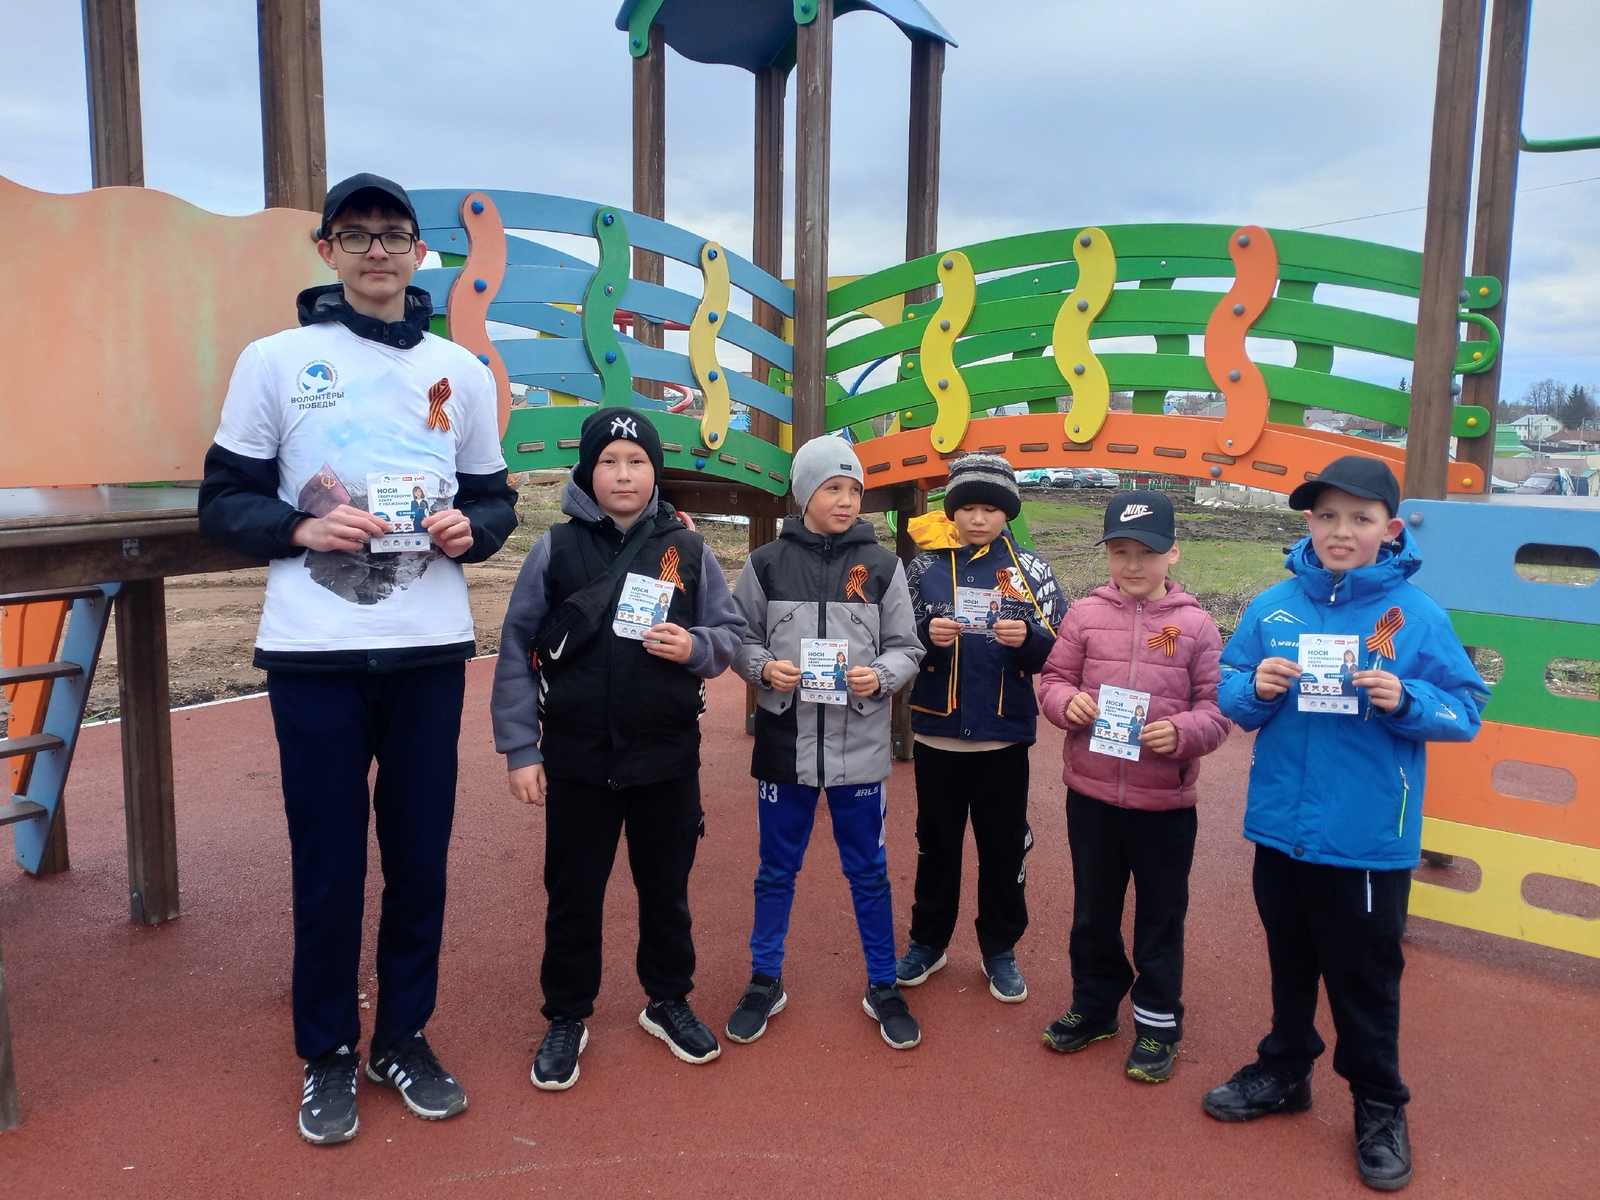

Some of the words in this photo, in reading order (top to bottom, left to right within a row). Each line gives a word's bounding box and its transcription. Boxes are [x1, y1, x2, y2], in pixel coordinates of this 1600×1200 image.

[291, 391, 345, 403] ВОЛОНТЁРЫ
[298, 400, 336, 410] ПОБЕДЫ
[610, 416, 638, 438] NY
[1124, 504, 1149, 515] NIKE
[1105, 699, 1124, 707] НОСИ
[759, 780, 778, 803] 33
